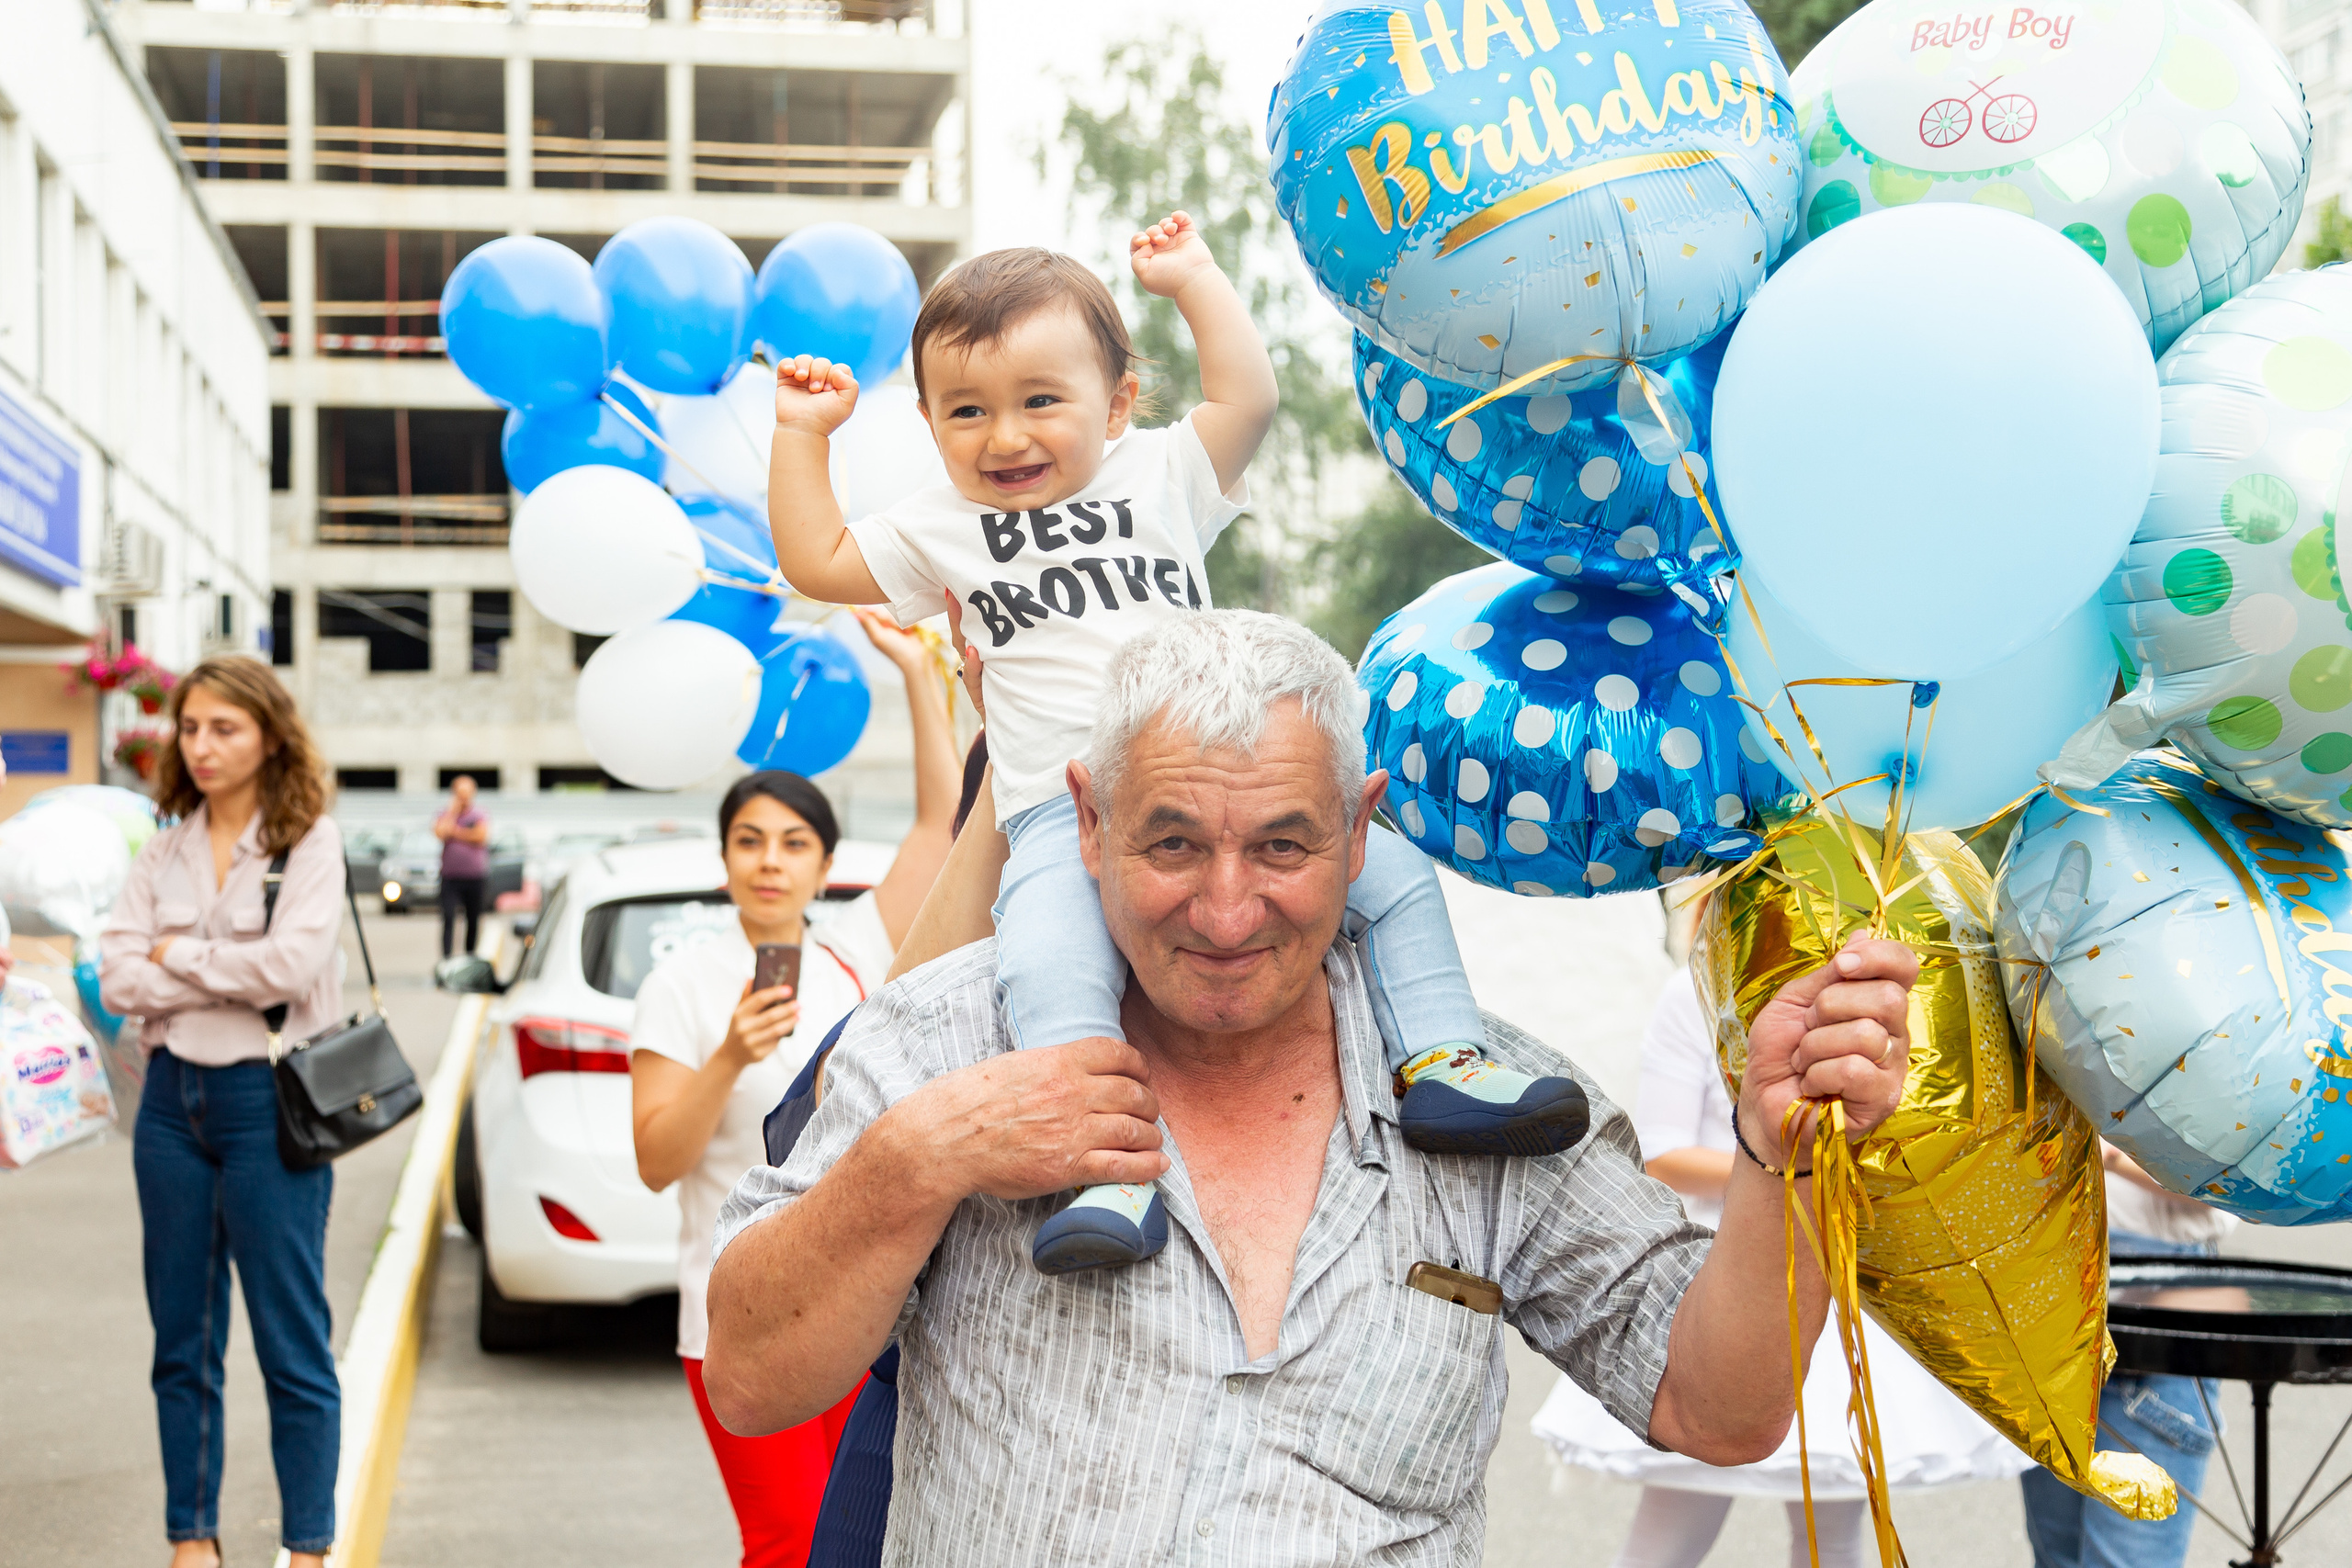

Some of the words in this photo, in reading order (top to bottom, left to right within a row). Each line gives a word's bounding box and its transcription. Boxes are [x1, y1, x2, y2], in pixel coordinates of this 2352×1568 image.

[1910, 14, 1995, 52] Baby
[2007, 7, 2075, 50] Boy
[1346, 31, 1779, 235] Birthday!
[979, 498, 1133, 563] BEST
